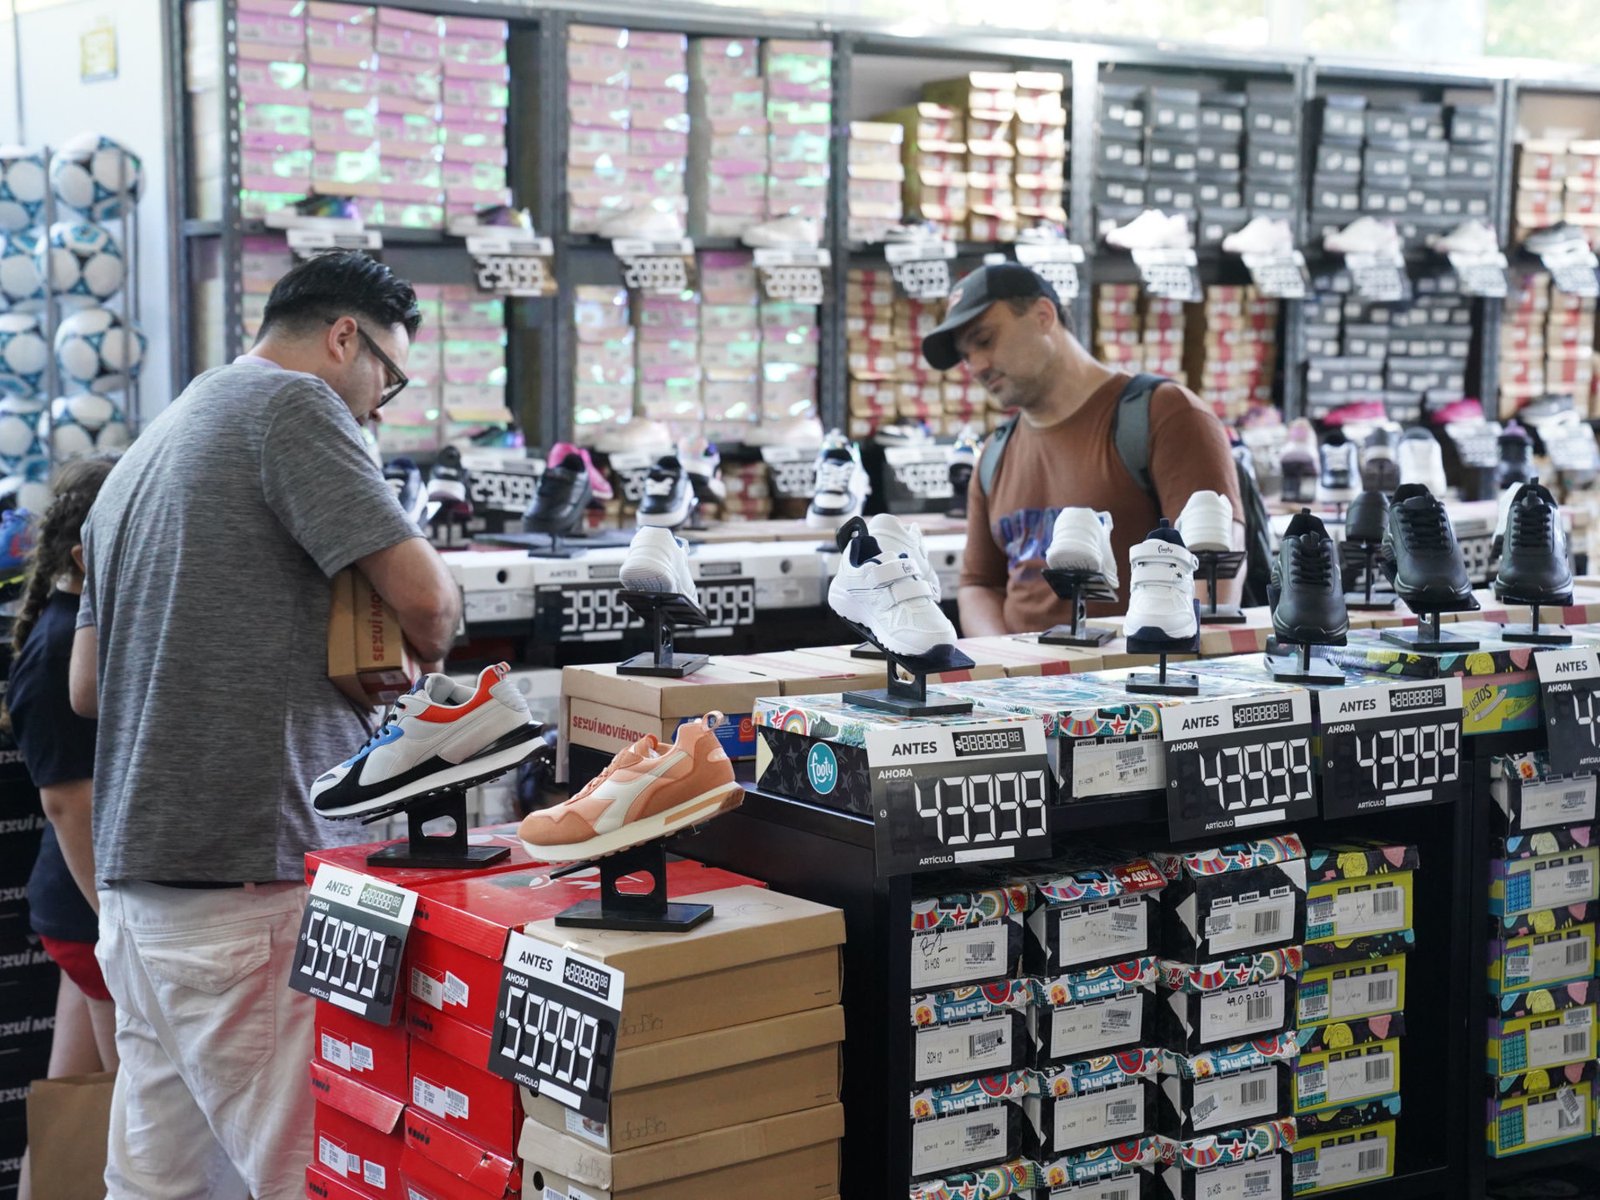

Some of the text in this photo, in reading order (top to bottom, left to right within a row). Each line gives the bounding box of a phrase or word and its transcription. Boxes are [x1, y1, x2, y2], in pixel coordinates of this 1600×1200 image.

[1555, 660, 1588, 673] ANTES
[1547, 683, 1572, 693] AHORA
[1339, 699, 1376, 713] ANTES
[1182, 715, 1219, 731] ANTES
[1573, 690, 1600, 748] 4
[1327, 723, 1356, 734] AHORA
[891, 741, 938, 757] ANTES
[1170, 741, 1199, 753] AHORA
[1356, 722, 1459, 790] 43999
[877, 768, 913, 780] AHORA
[1200, 738, 1313, 811] 43999
[914, 770, 1047, 845] 43999
[1358, 798, 1385, 809] ARTÍCULO
[1205, 818, 1234, 830] ARTÍCULO
[919, 855, 953, 866] ARTÍCULO
[325, 879, 353, 897] ANTES
[310, 899, 330, 912] AHORA
[300, 911, 386, 999] 59999
[519, 951, 553, 972] ANTES
[505, 971, 529, 988] AHORA
[309, 987, 329, 1000] ARTÍCULO
[500, 986, 599, 1092] 59999
[514, 1072, 539, 1089] ARTÍCULO
